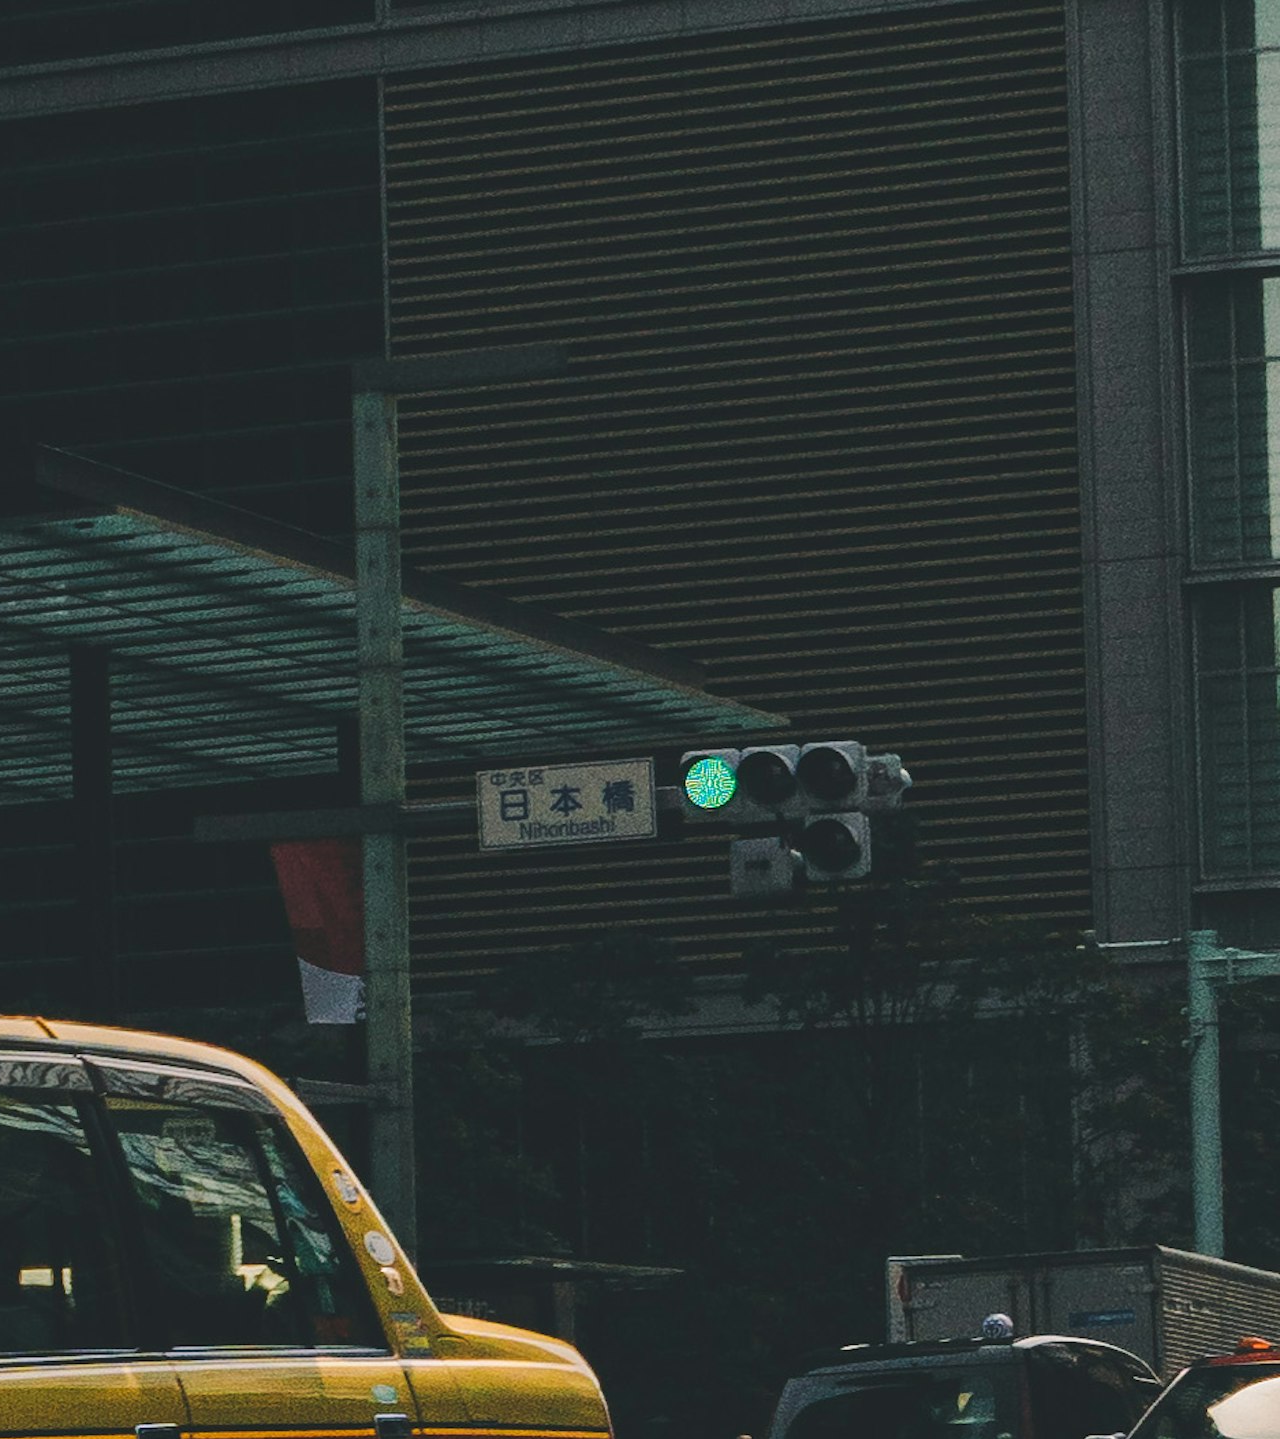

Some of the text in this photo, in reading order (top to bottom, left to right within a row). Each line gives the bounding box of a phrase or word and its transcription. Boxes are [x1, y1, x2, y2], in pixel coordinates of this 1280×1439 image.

[490, 769, 544, 787] 中央区
[500, 779, 635, 821] 日本橋
[519, 816, 615, 840] Nihonbashi
